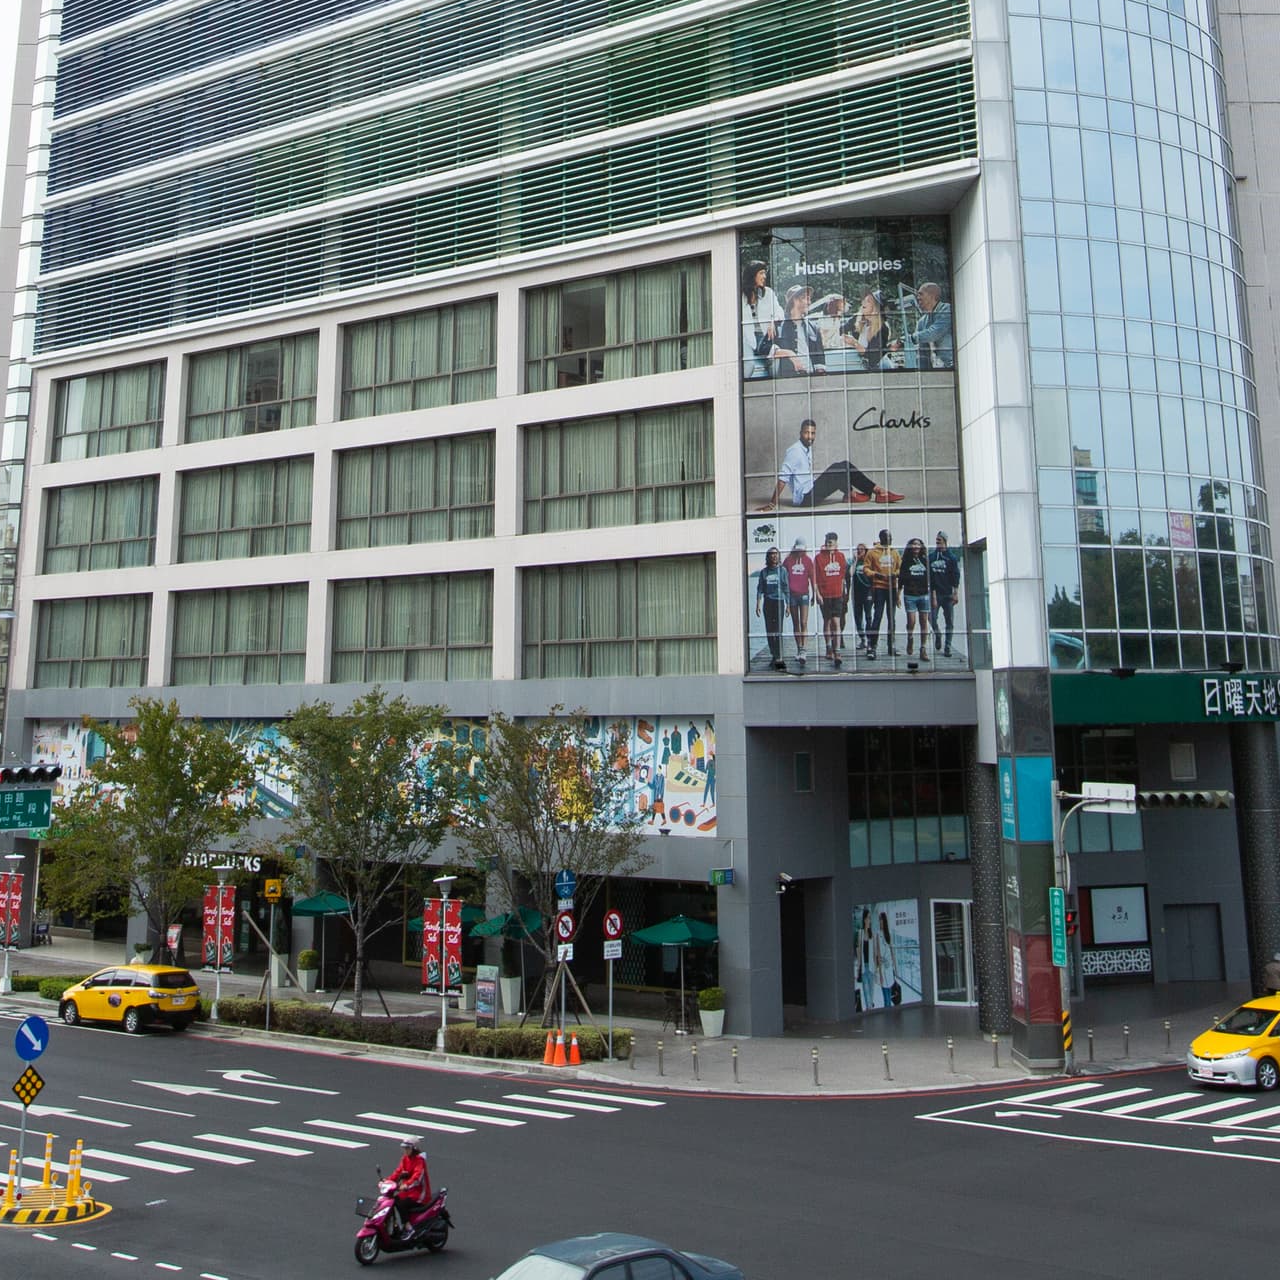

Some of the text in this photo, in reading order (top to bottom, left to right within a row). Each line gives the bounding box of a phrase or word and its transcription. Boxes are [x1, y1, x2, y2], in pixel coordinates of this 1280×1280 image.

[795, 257, 902, 276] Hush Puppies
[853, 407, 930, 431] Clarks
